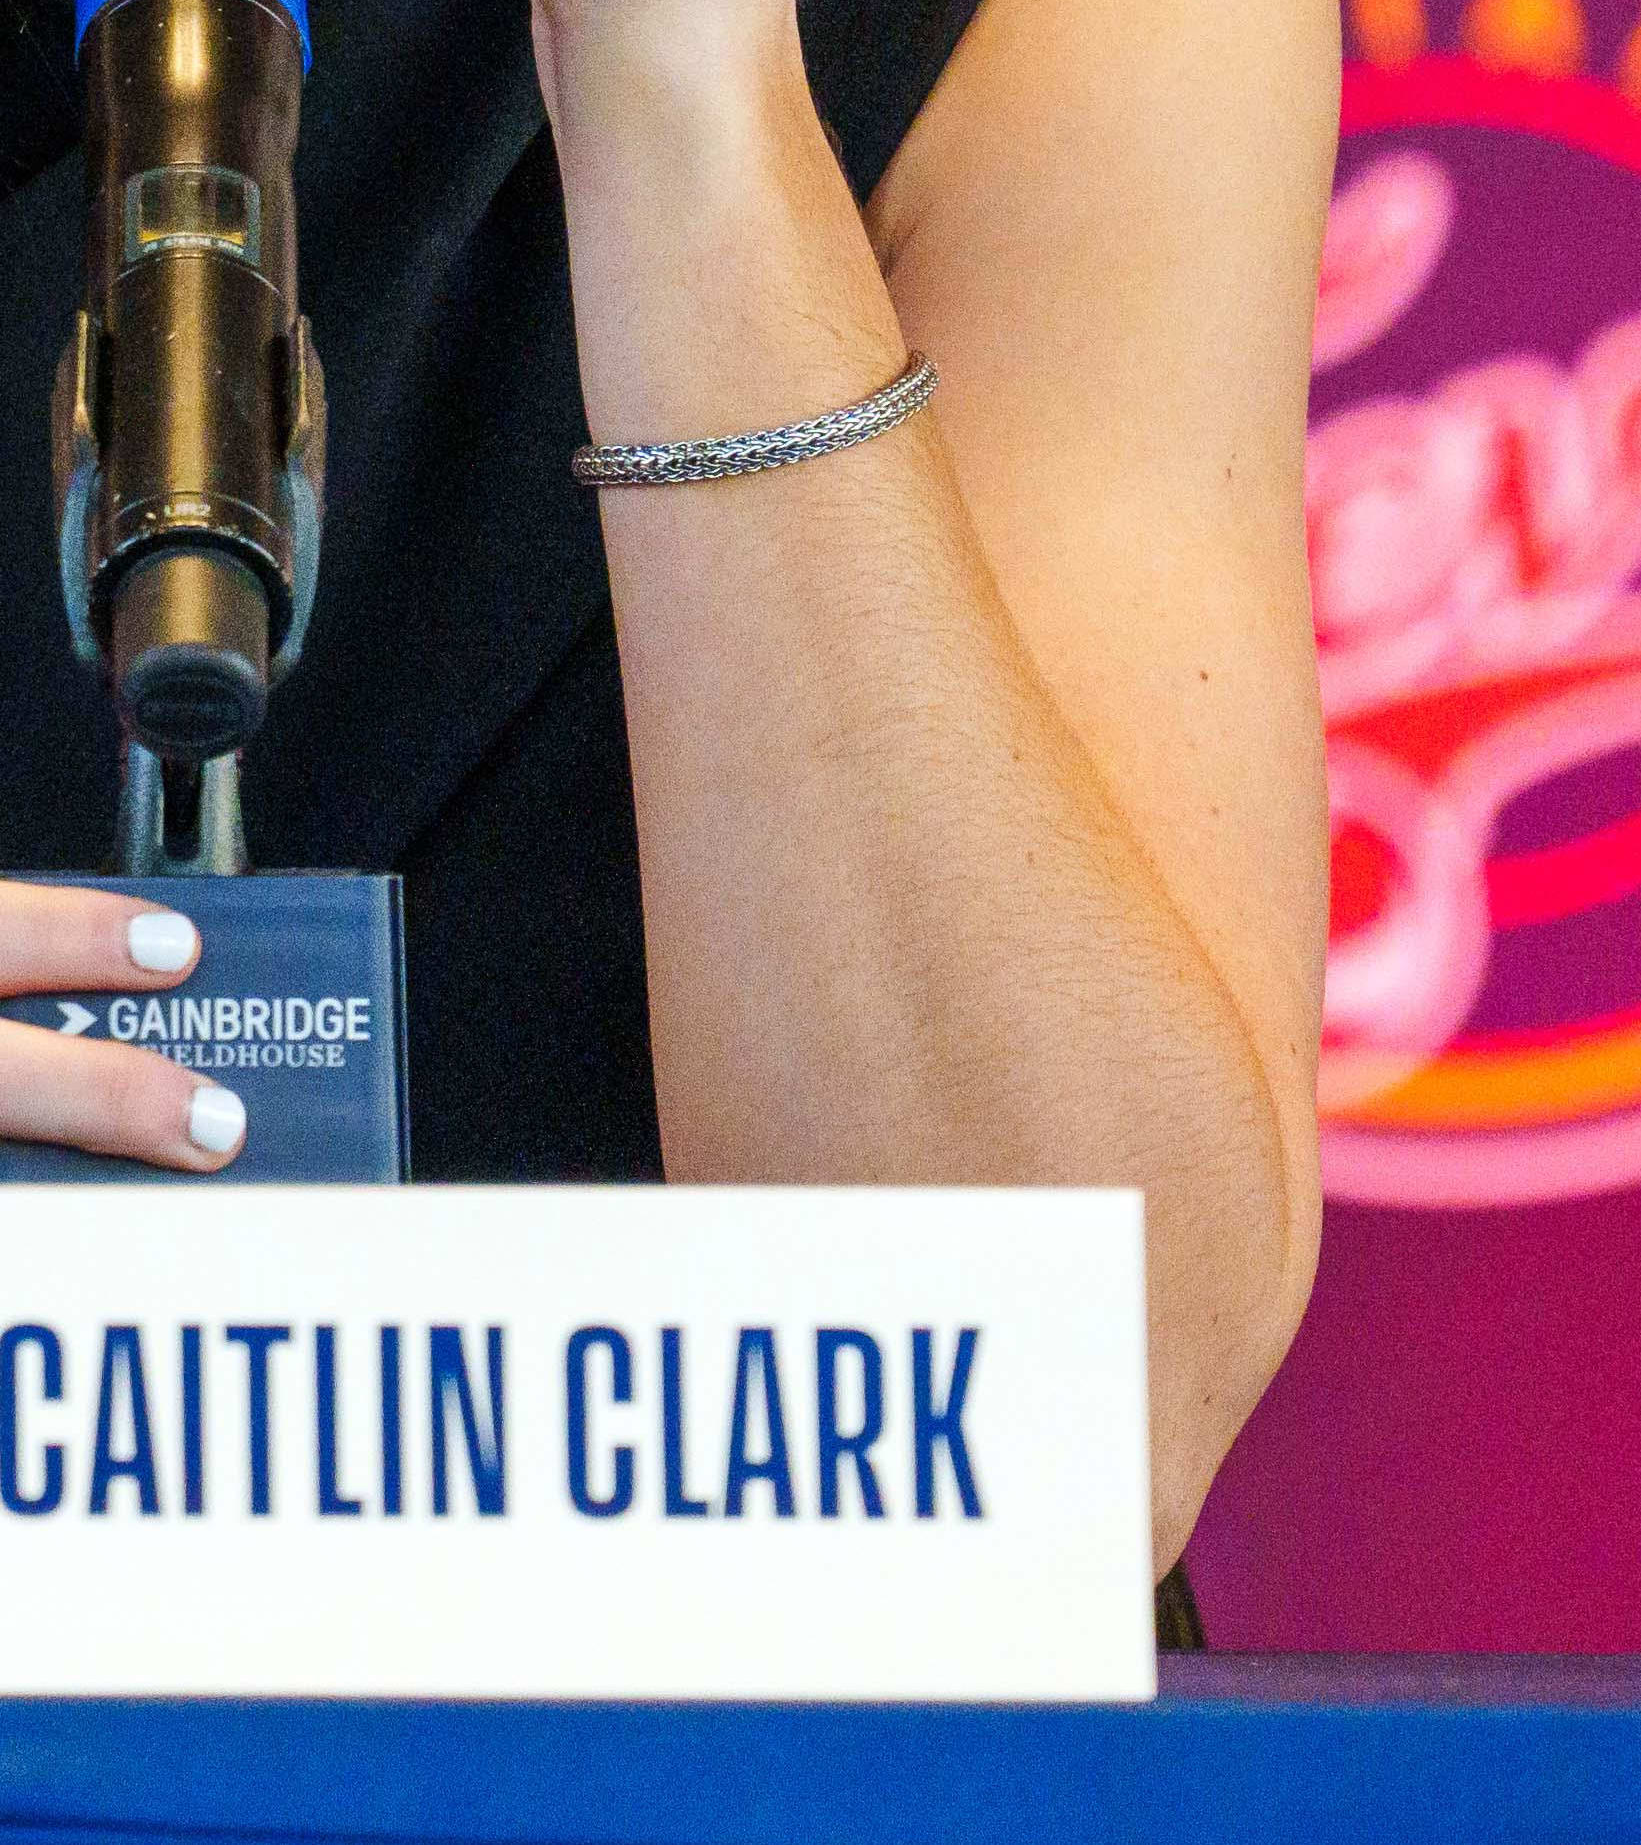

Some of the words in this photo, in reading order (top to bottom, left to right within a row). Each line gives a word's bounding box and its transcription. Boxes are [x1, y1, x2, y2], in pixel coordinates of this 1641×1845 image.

[107, 997, 370, 1041] GAINBRIDGE
[140, 1043, 347, 1068] IELDHOUSE
[565, 1325, 986, 1520] CLARK
